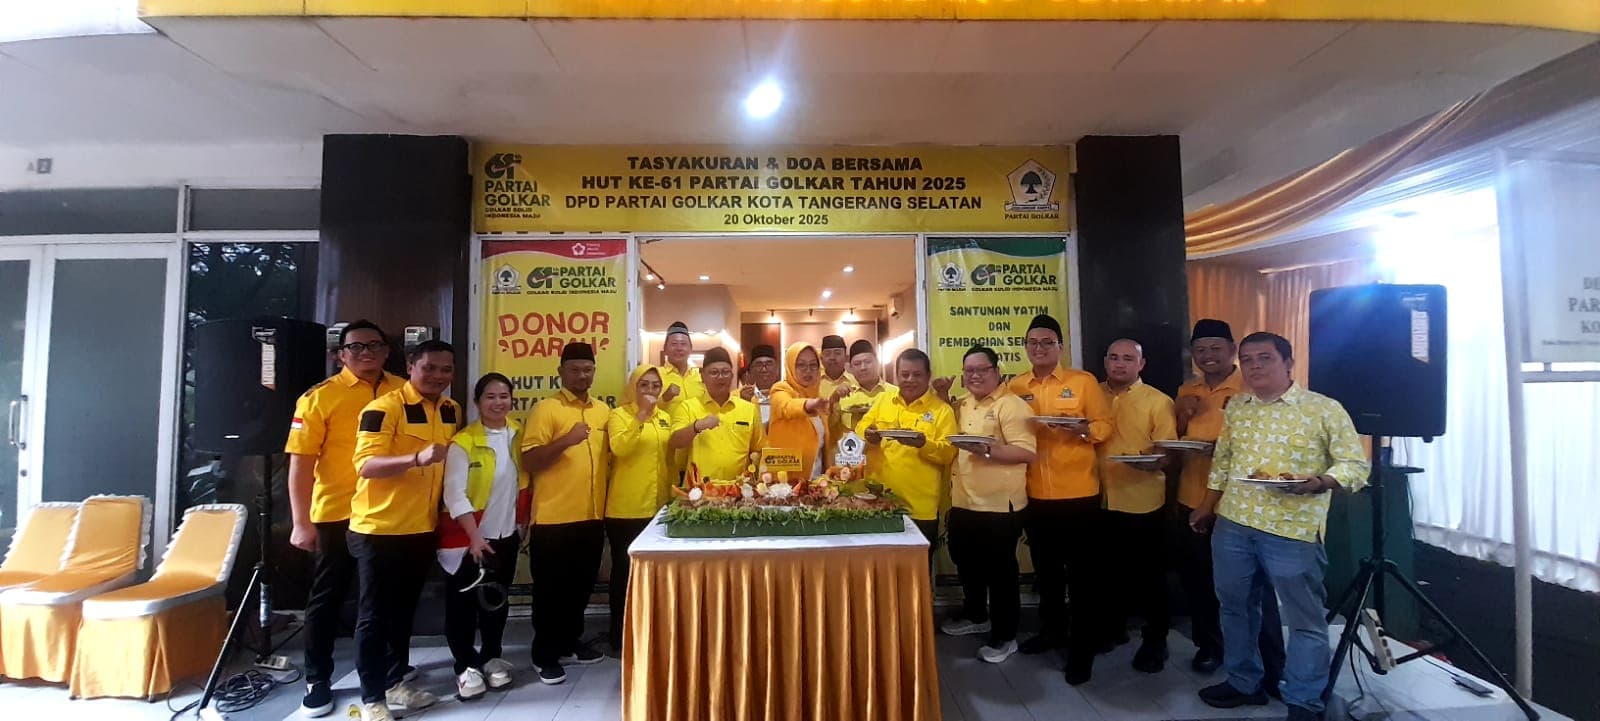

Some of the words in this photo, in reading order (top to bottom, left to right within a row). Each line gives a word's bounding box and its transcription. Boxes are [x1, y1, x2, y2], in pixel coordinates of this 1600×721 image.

[627, 156, 759, 170] TASYAKURAN
[766, 157, 779, 170] &
[786, 157, 826, 170] DOA
[831, 157, 923, 170] BERSAMA
[484, 180, 538, 193] PARTAI
[582, 176, 622, 189] HUT
[629, 176, 682, 190] KE-61
[690, 176, 760, 190] PARTAI
[765, 177, 845, 190] GOLKAR
[851, 177, 917, 190] TAHUN
[922, 177, 967, 190] 2025
[484, 194, 551, 207] GOLKAR
[565, 195, 600, 209] DPD
[605, 195, 667, 209] PARTAI
[672, 195, 743, 209] GOLKAR
[747, 195, 794, 209] KOTA
[798, 196, 902, 209] TANGERANG
[907, 196, 982, 210] SELATAN
[724, 214, 739, 225] 20
[743, 213, 794, 225] Oktober
[798, 214, 829, 225] 2025
[560, 266, 606, 277] PARTAI
[1002, 263, 1046, 275] PARTAI
[559, 277, 617, 289] GOLKAR
[1002, 275, 1057, 286] GOLKAR
[949, 306, 1010, 316] SANTUNAN
[1013, 305, 1049, 315] YATIM
[498, 311, 610, 337] DONOR
[988, 321, 1011, 331] DAN
[938, 336, 1005, 347] PEMBAGIAN
[511, 375, 544, 390] HUT
